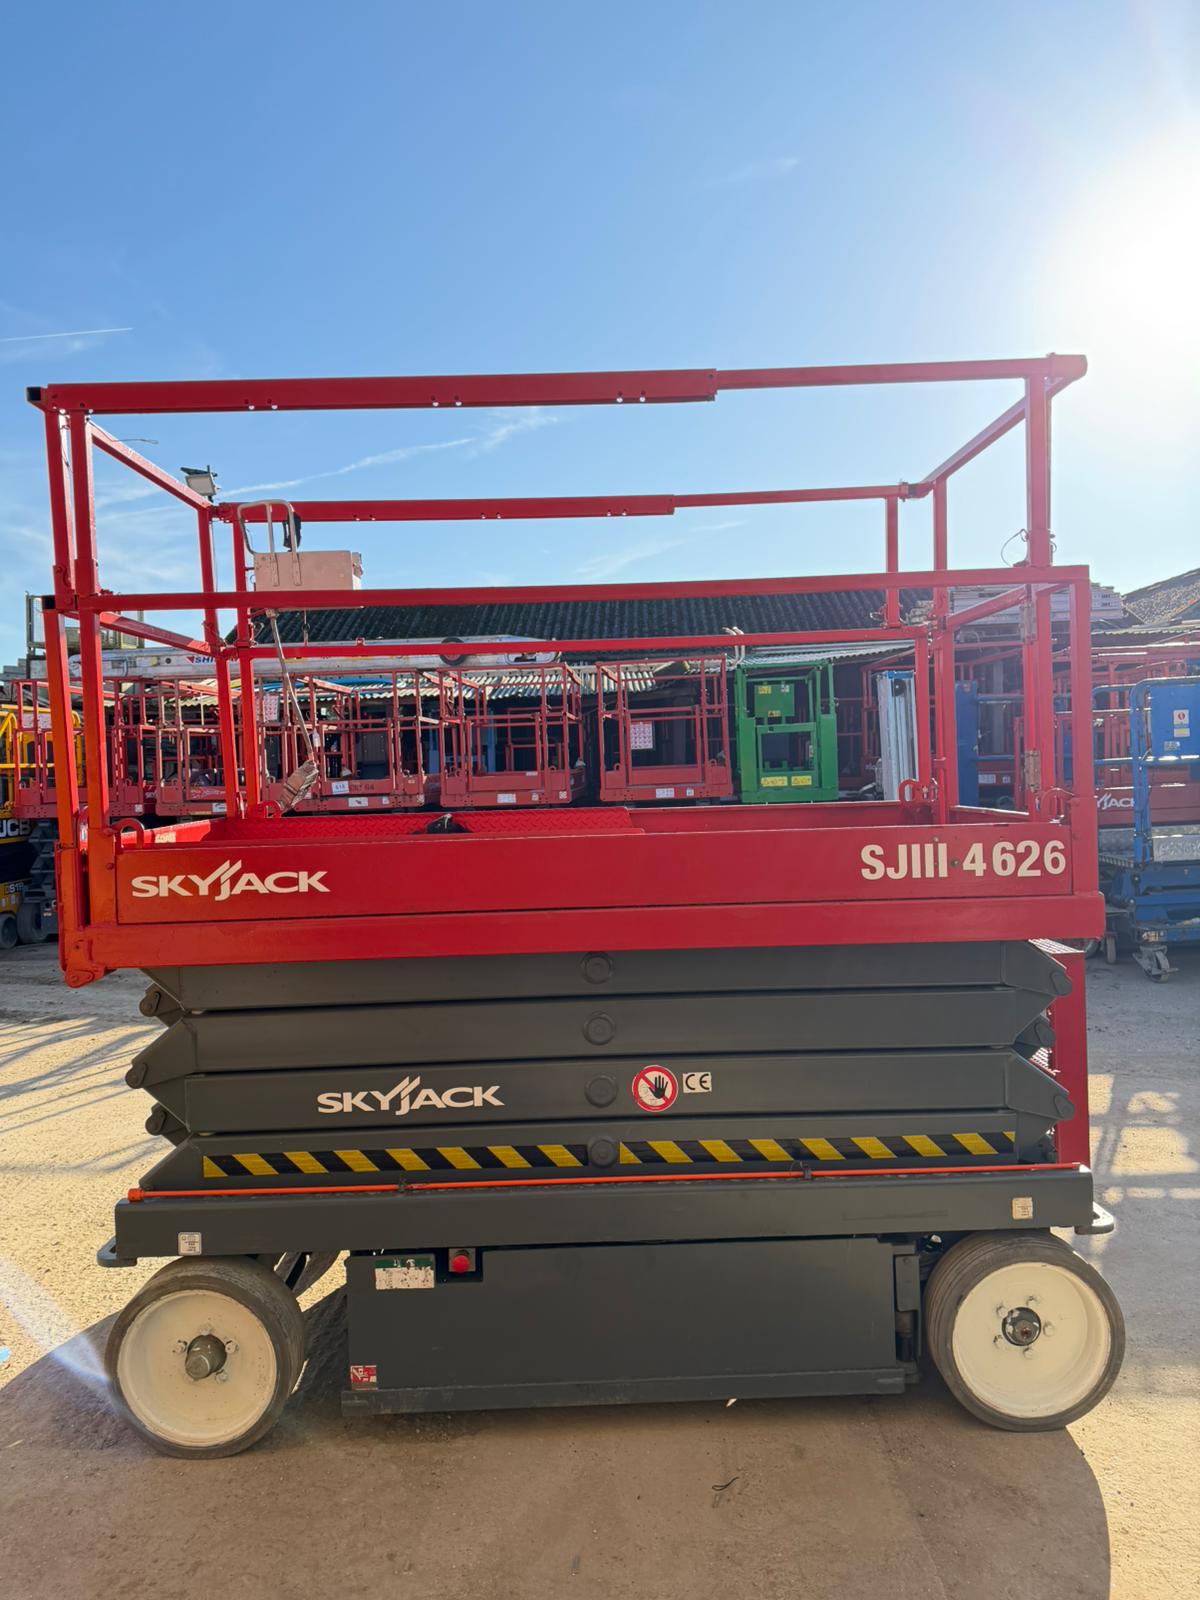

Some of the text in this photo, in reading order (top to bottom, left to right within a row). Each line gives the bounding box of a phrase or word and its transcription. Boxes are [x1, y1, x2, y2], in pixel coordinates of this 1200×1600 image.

[1096, 793, 1135, 810] YJAC
[0, 819, 30, 838] JCB
[962, 840, 1067, 877] 4626
[131, 859, 331, 902] SKYJACK
[317, 1076, 505, 1116] SKYJACK
[685, 1073, 710, 1091] CE
